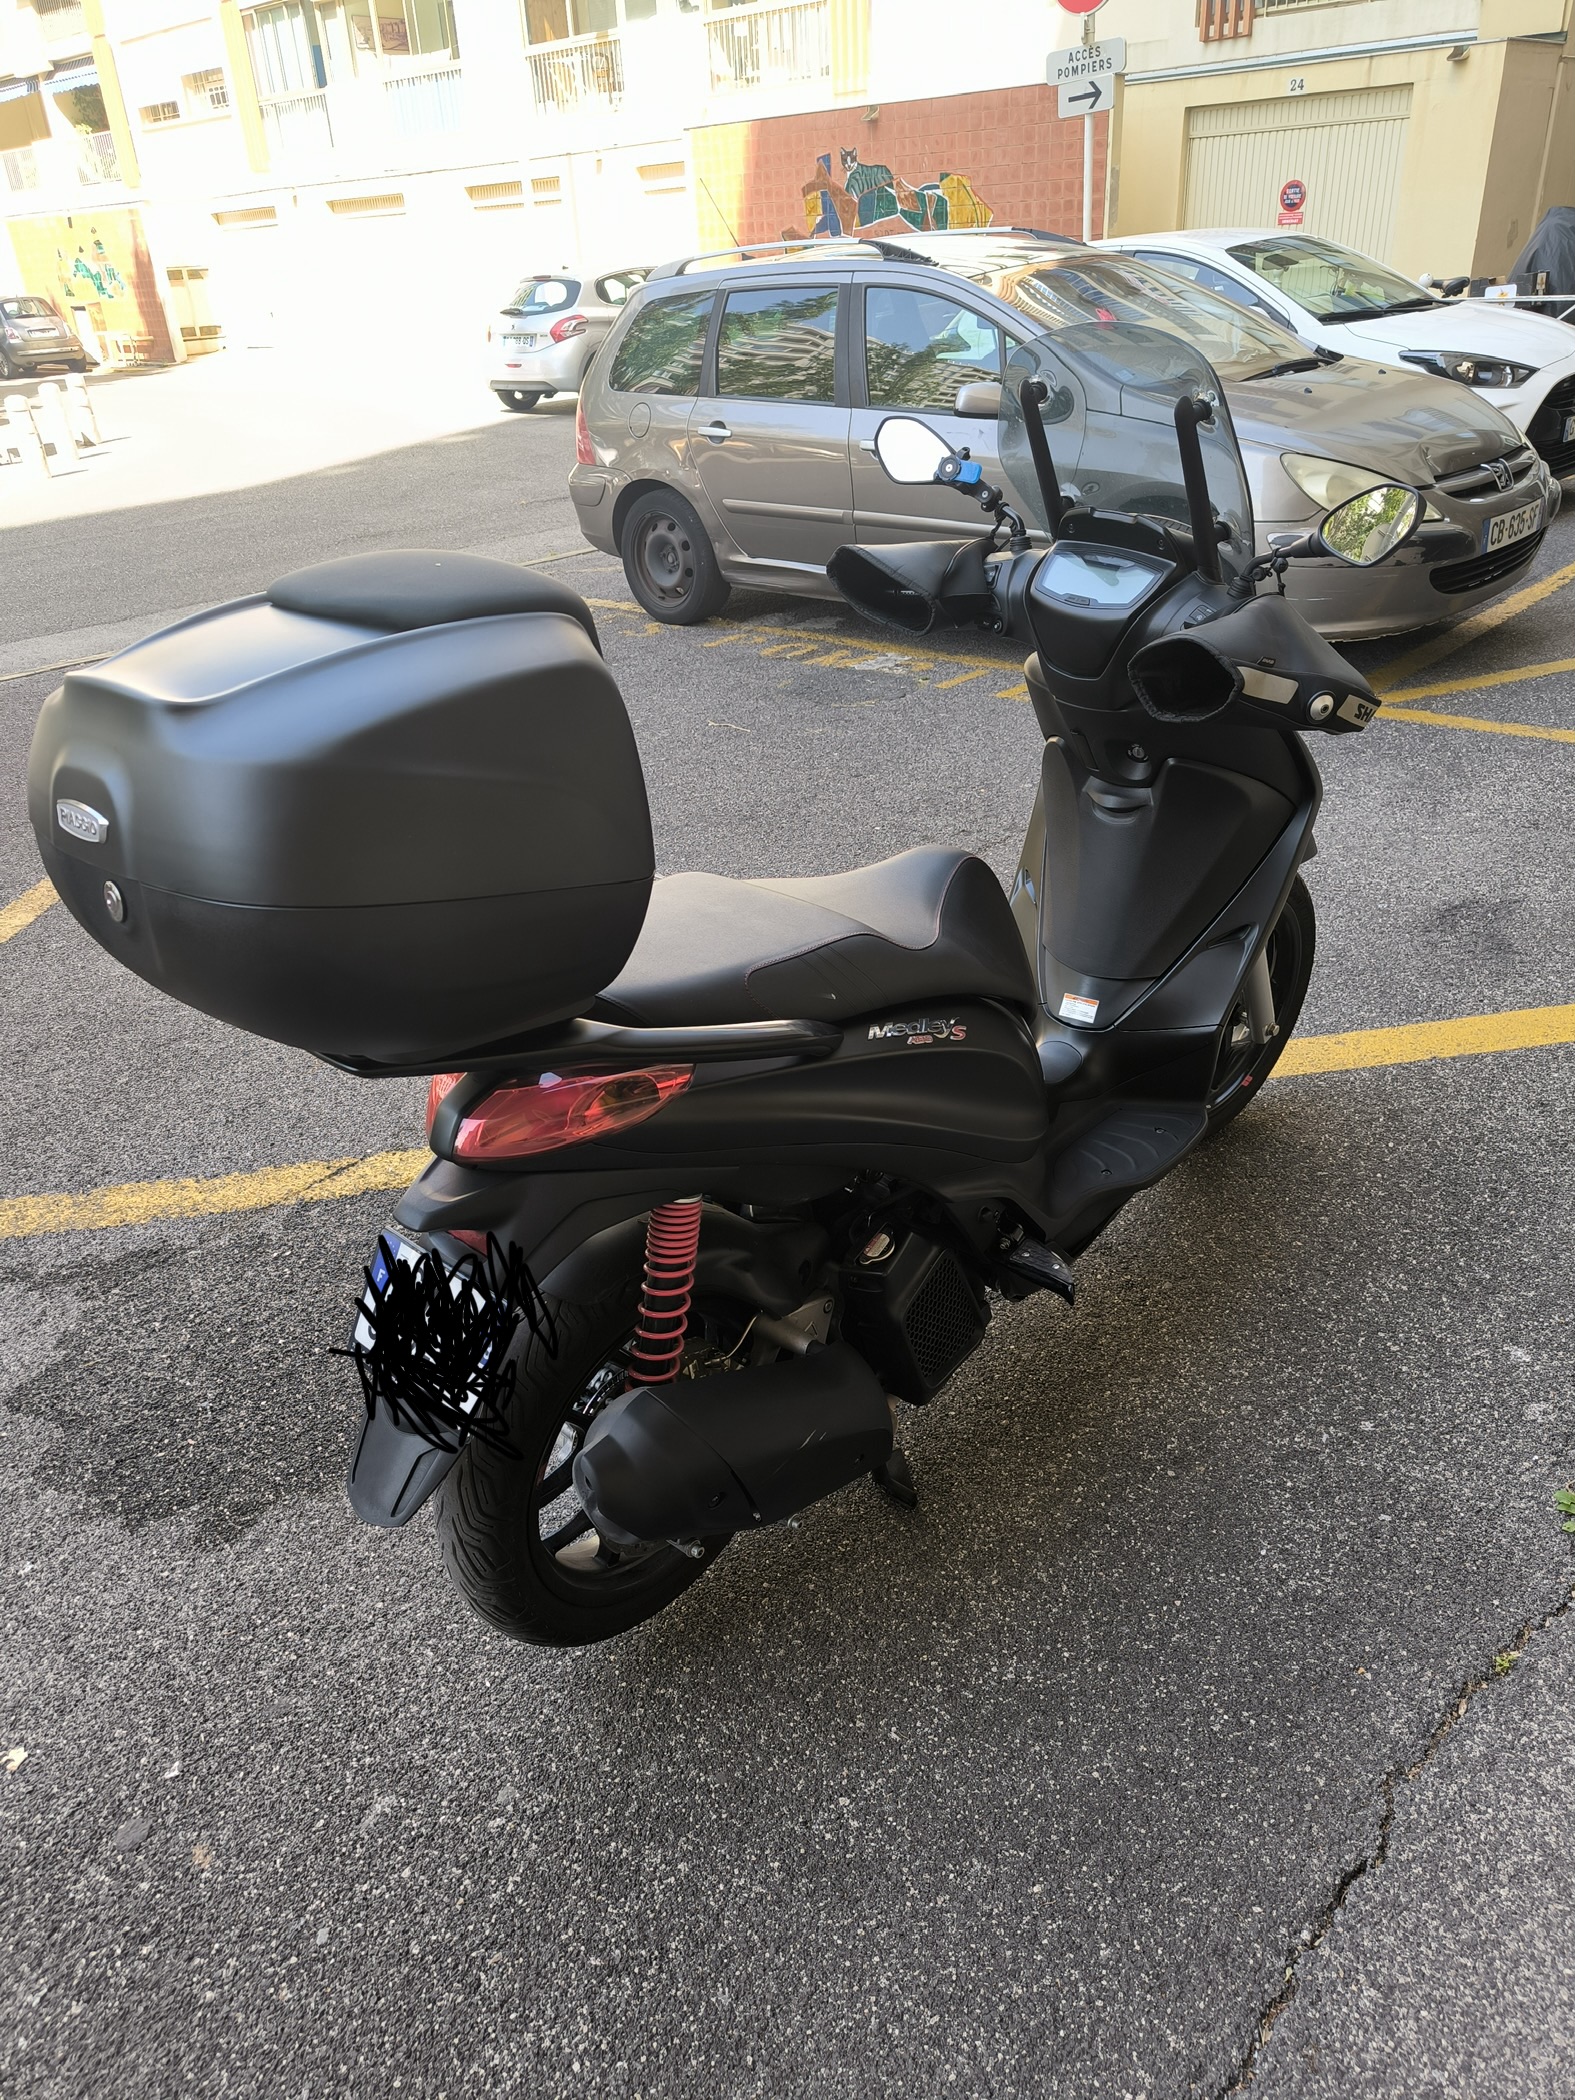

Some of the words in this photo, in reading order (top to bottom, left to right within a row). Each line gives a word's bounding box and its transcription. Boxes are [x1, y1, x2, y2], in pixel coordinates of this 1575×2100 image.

[1068, 45, 1101, 64] ACCÈS
[1057, 57, 1112, 80] POMPIERS
[1290, 78, 1304, 91] 24
[60, 806, 98, 835] PIAGGIO
[376, 1268, 386, 1282] F
